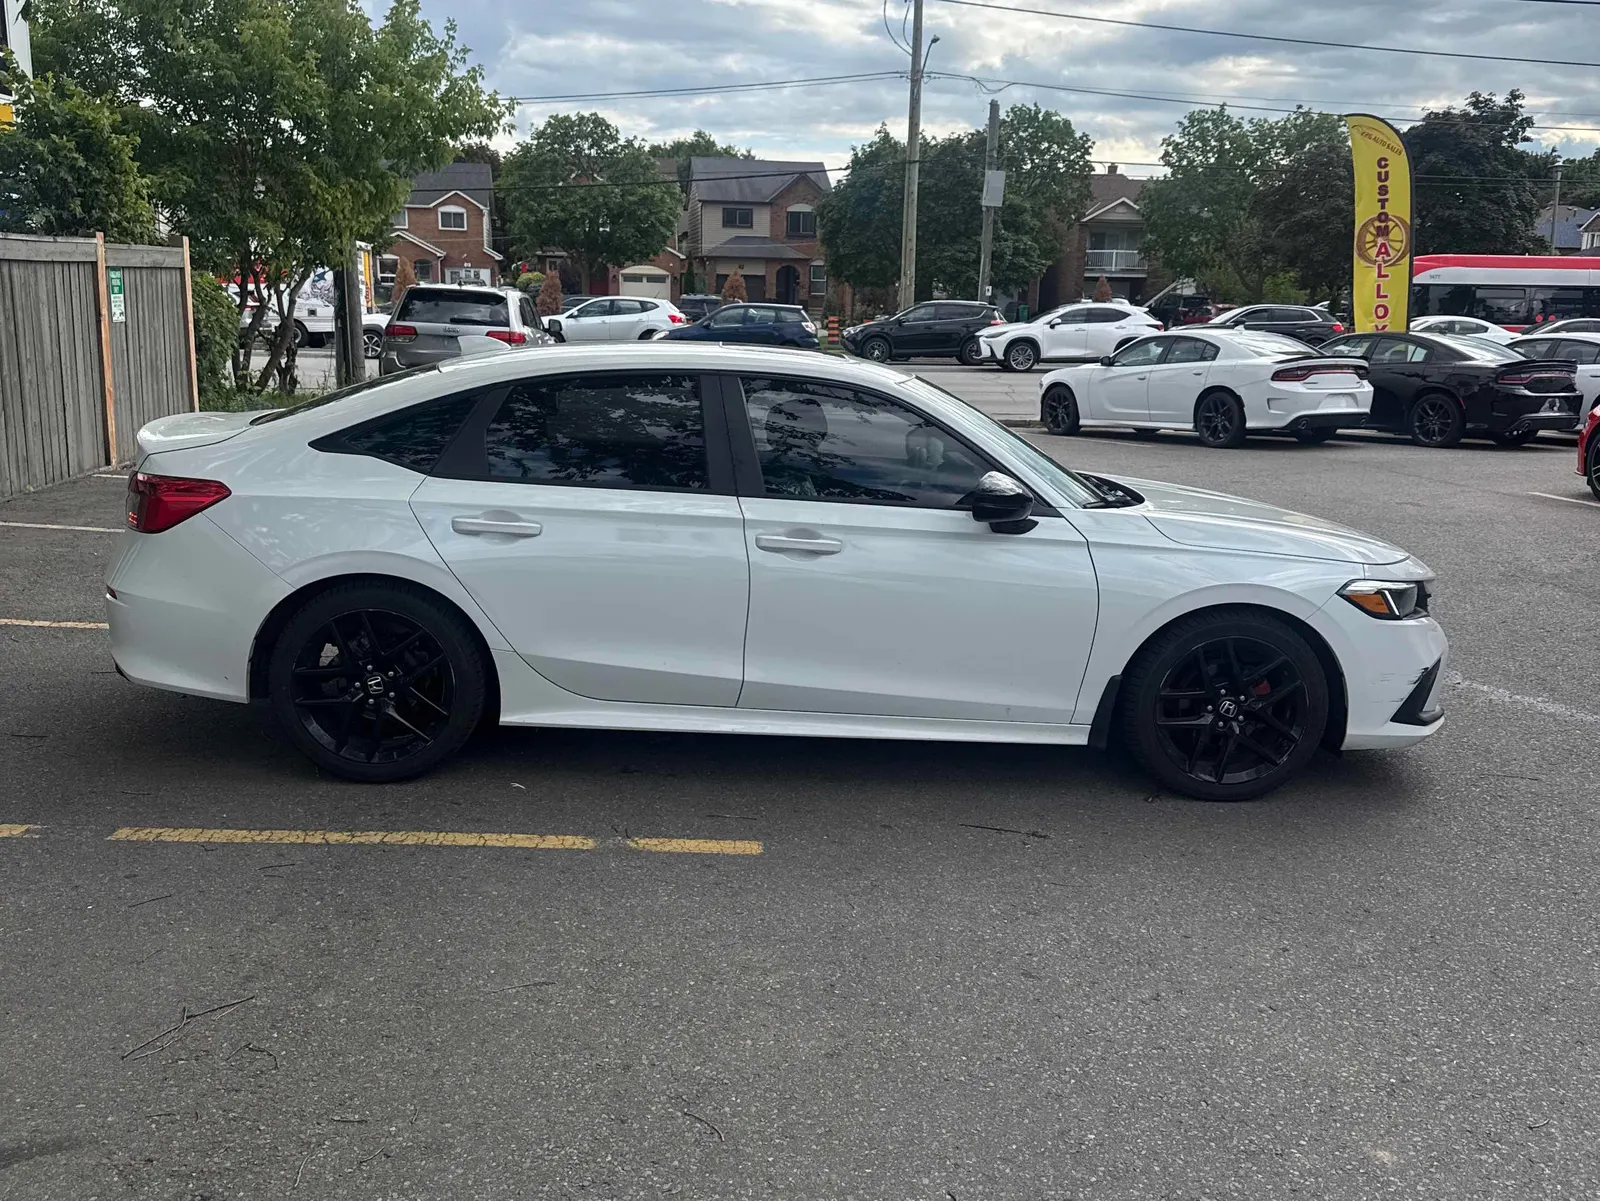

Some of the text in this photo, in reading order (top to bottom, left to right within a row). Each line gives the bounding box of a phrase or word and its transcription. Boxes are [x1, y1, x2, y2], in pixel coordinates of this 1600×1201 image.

[1372, 136, 1387, 147] AUTO
[1386, 143, 1403, 156] SALES
[1376, 157, 1389, 237] CUSTOM
